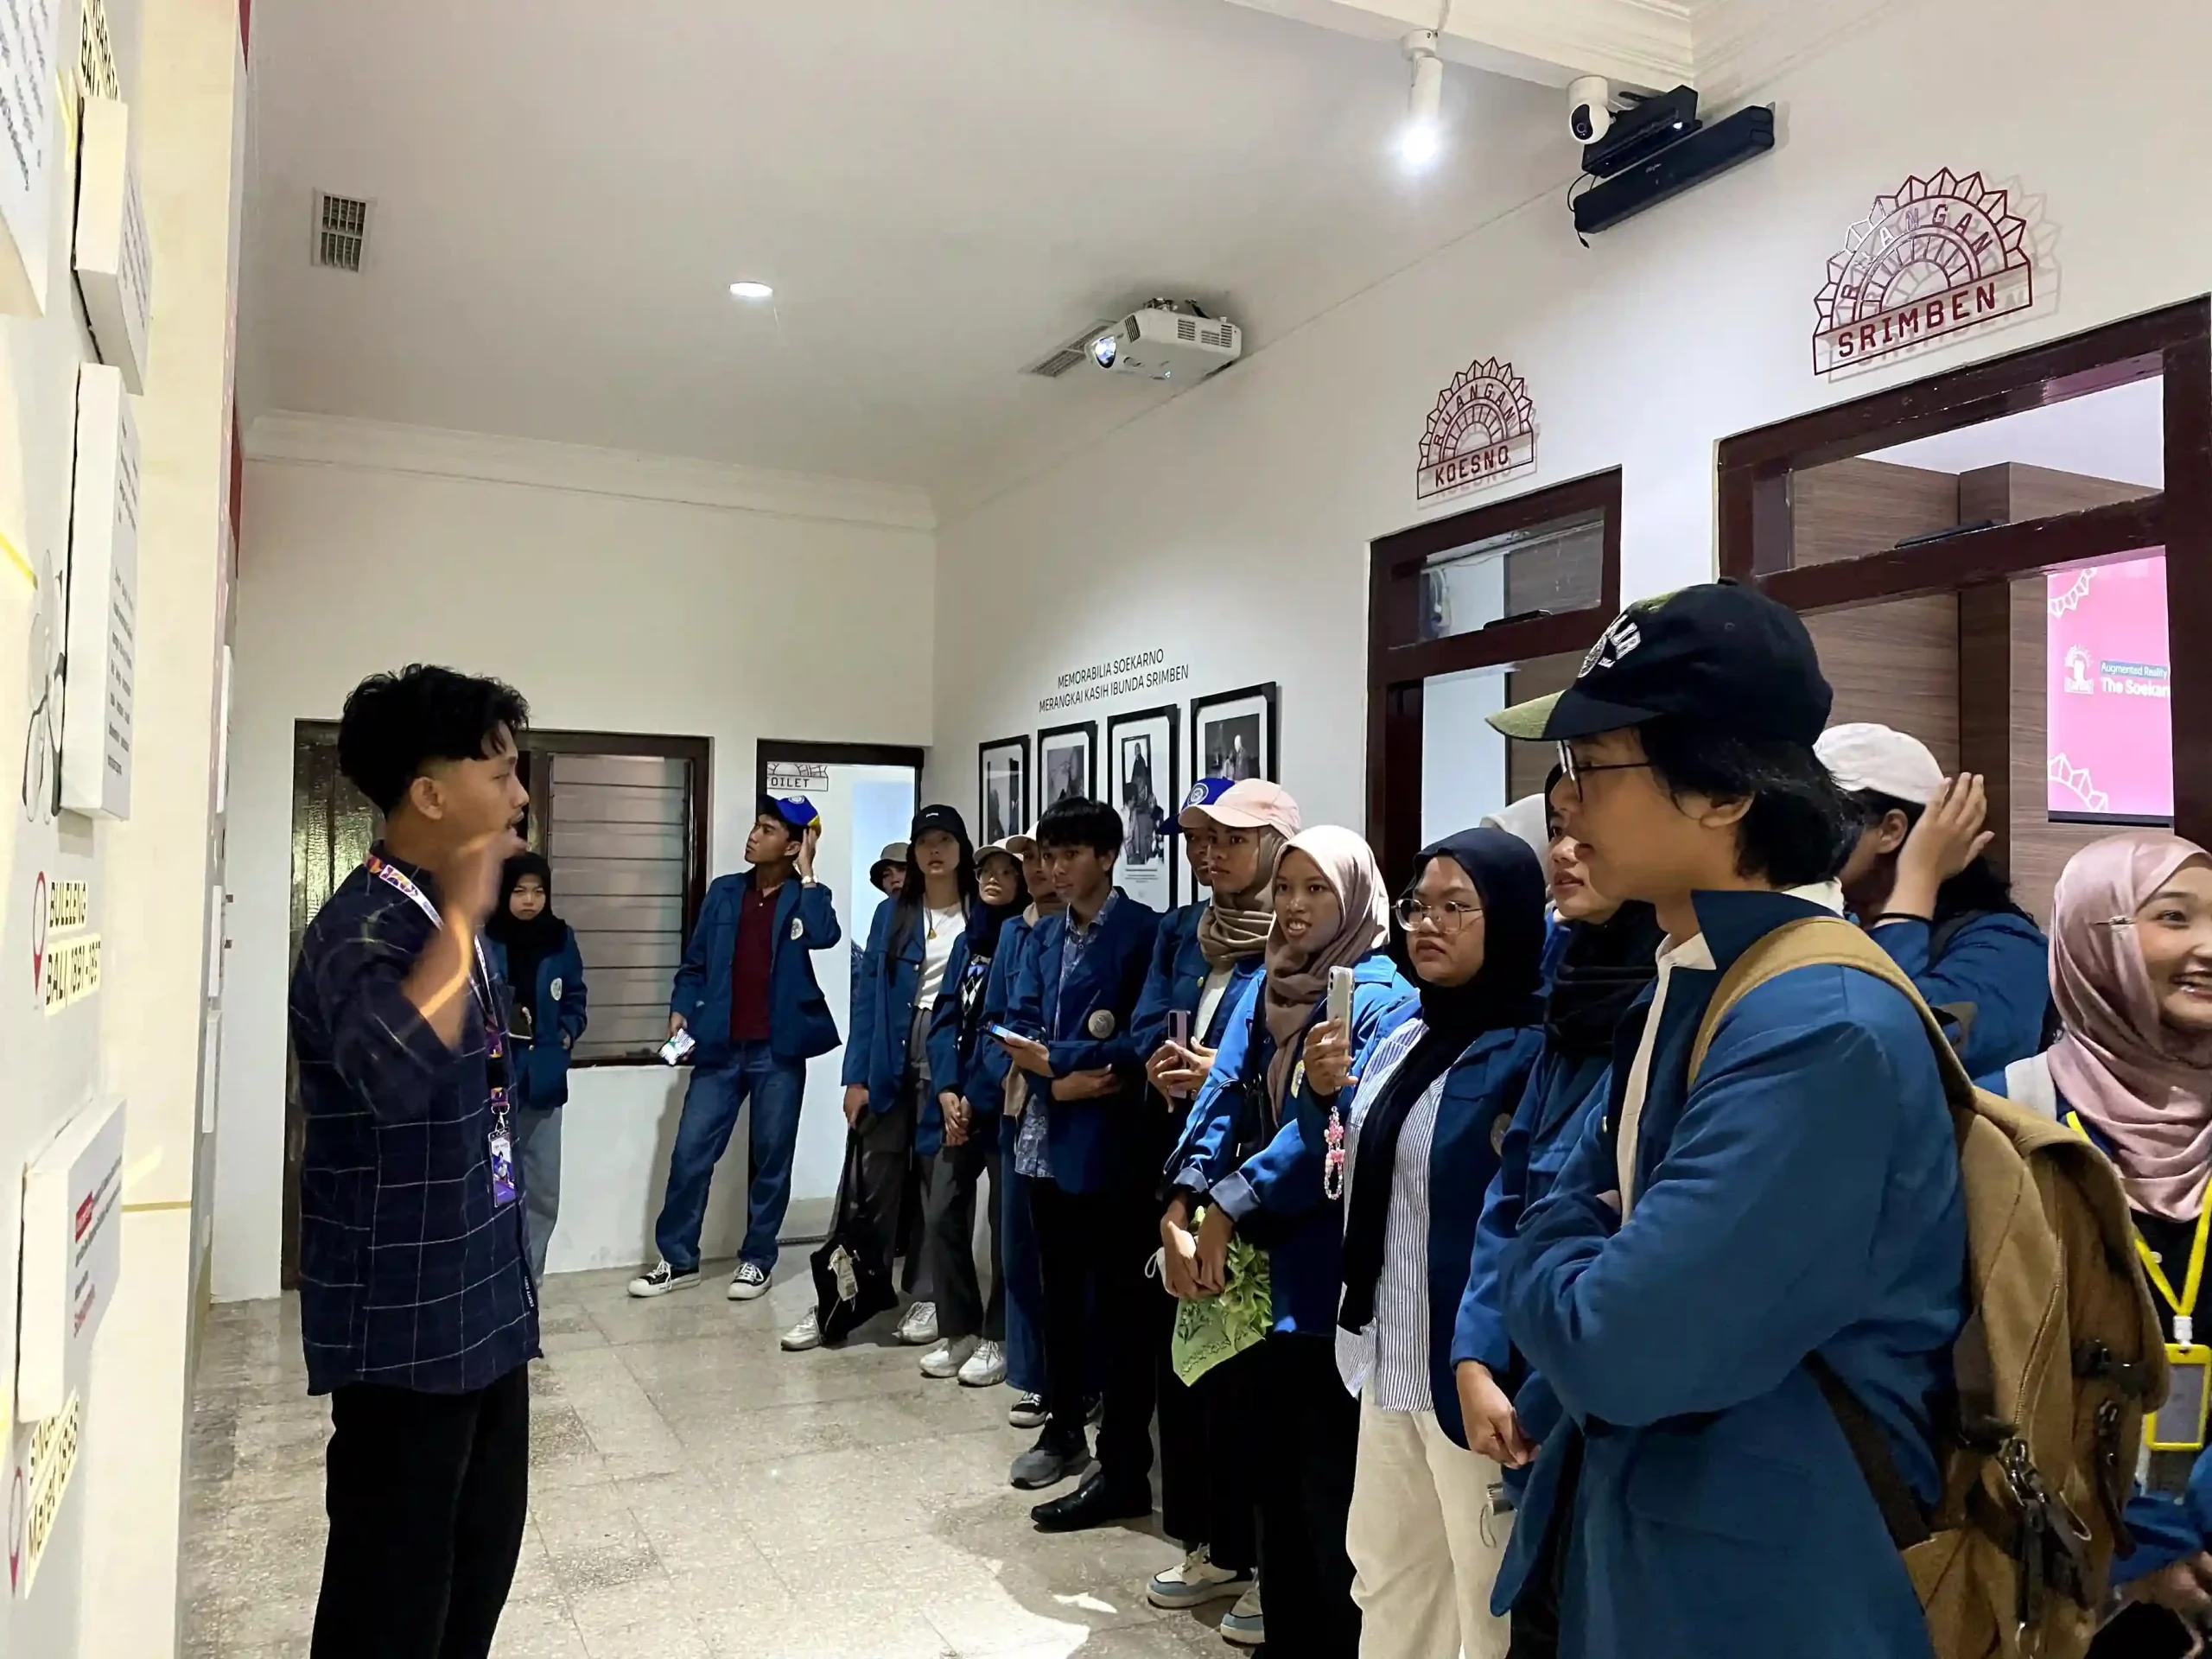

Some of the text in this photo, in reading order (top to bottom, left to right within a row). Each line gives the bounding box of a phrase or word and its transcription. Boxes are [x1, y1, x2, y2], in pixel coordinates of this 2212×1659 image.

[1838, 283, 1996, 358] SRIMBEN
[1433, 383, 1516, 447] RUANGAN
[1435, 445, 1510, 487] KOESNO
[1039, 664, 1189, 713] MERANGKAI KASIH IBUNDA SRIMBEN
[1058, 648, 1164, 690] MEMORABILIA SOEKARNO
[2101, 662, 2167, 680] Augmented Reality
[2101, 677, 2124, 694] The
[767, 776, 810, 788] OILET
[49, 881, 86, 927] BULELENG
